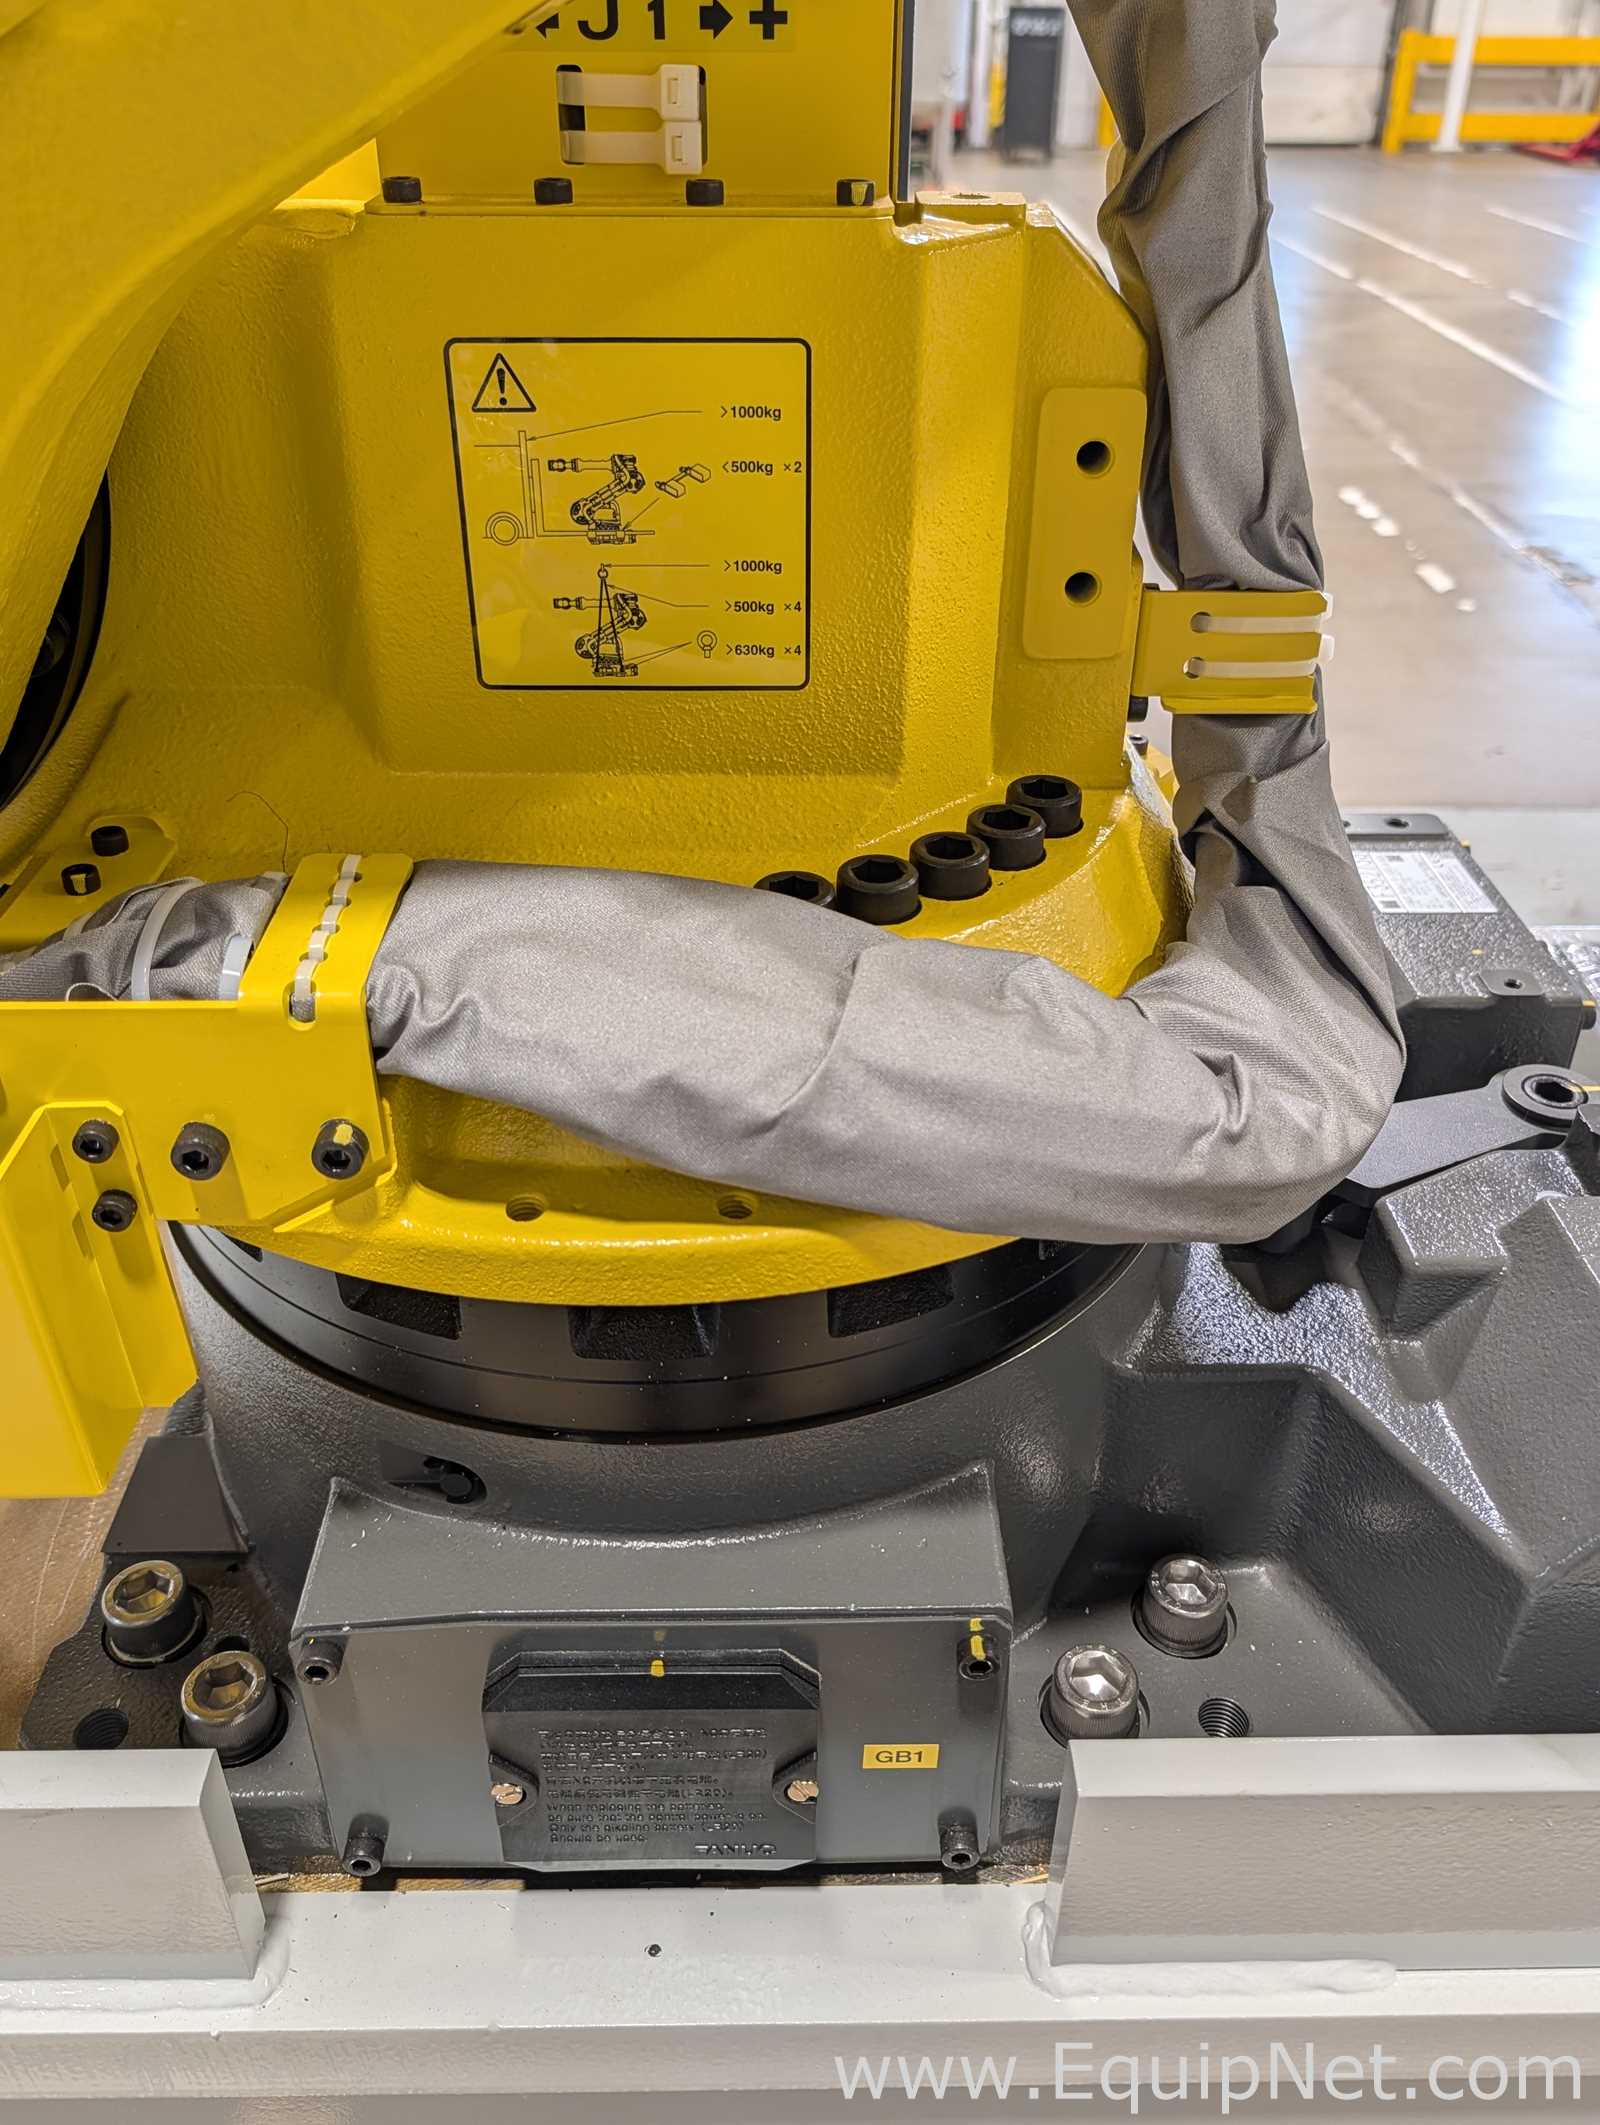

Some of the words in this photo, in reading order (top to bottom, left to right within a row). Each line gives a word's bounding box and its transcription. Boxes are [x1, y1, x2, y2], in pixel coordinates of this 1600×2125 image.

[721, 406, 781, 421] >1000kg
[724, 560, 782, 574] >1000kg
[725, 601, 774, 615] >500kg
[726, 644, 775, 658] >630kg
[875, 1750, 923, 1763] GB1
